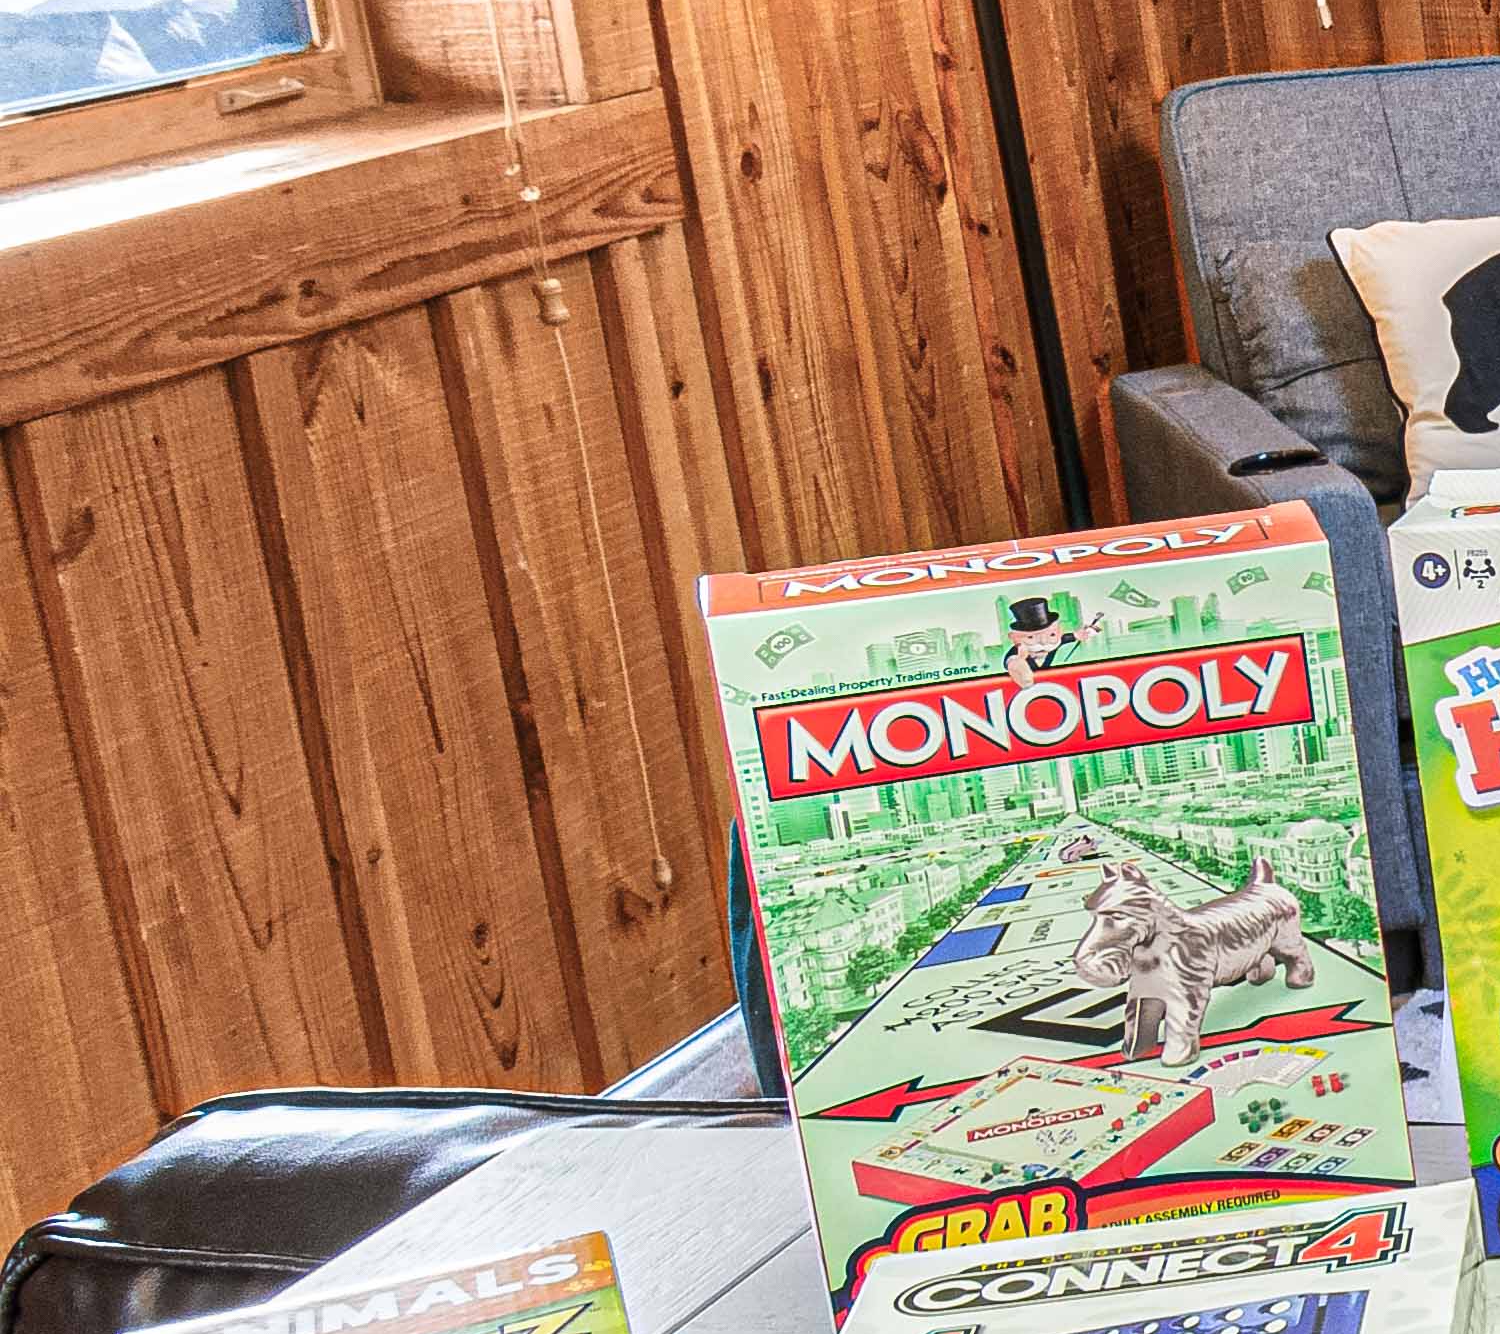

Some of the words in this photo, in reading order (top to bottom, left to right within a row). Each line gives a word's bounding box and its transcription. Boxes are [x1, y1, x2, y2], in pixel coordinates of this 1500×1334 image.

[783, 522, 1247, 598] MONOPOLY
[761, 682, 836, 702] Fast-Dealing
[838, 674, 893, 693] Property
[896, 670, 939, 689] Trading
[943, 663, 979, 677] Game
[788, 651, 1290, 782] MONOPOLY
[974, 1106, 1101, 1141] MONOPOLY
[912, 1238, 1301, 1312] CONNECT
[1302, 1207, 1398, 1267] 4
